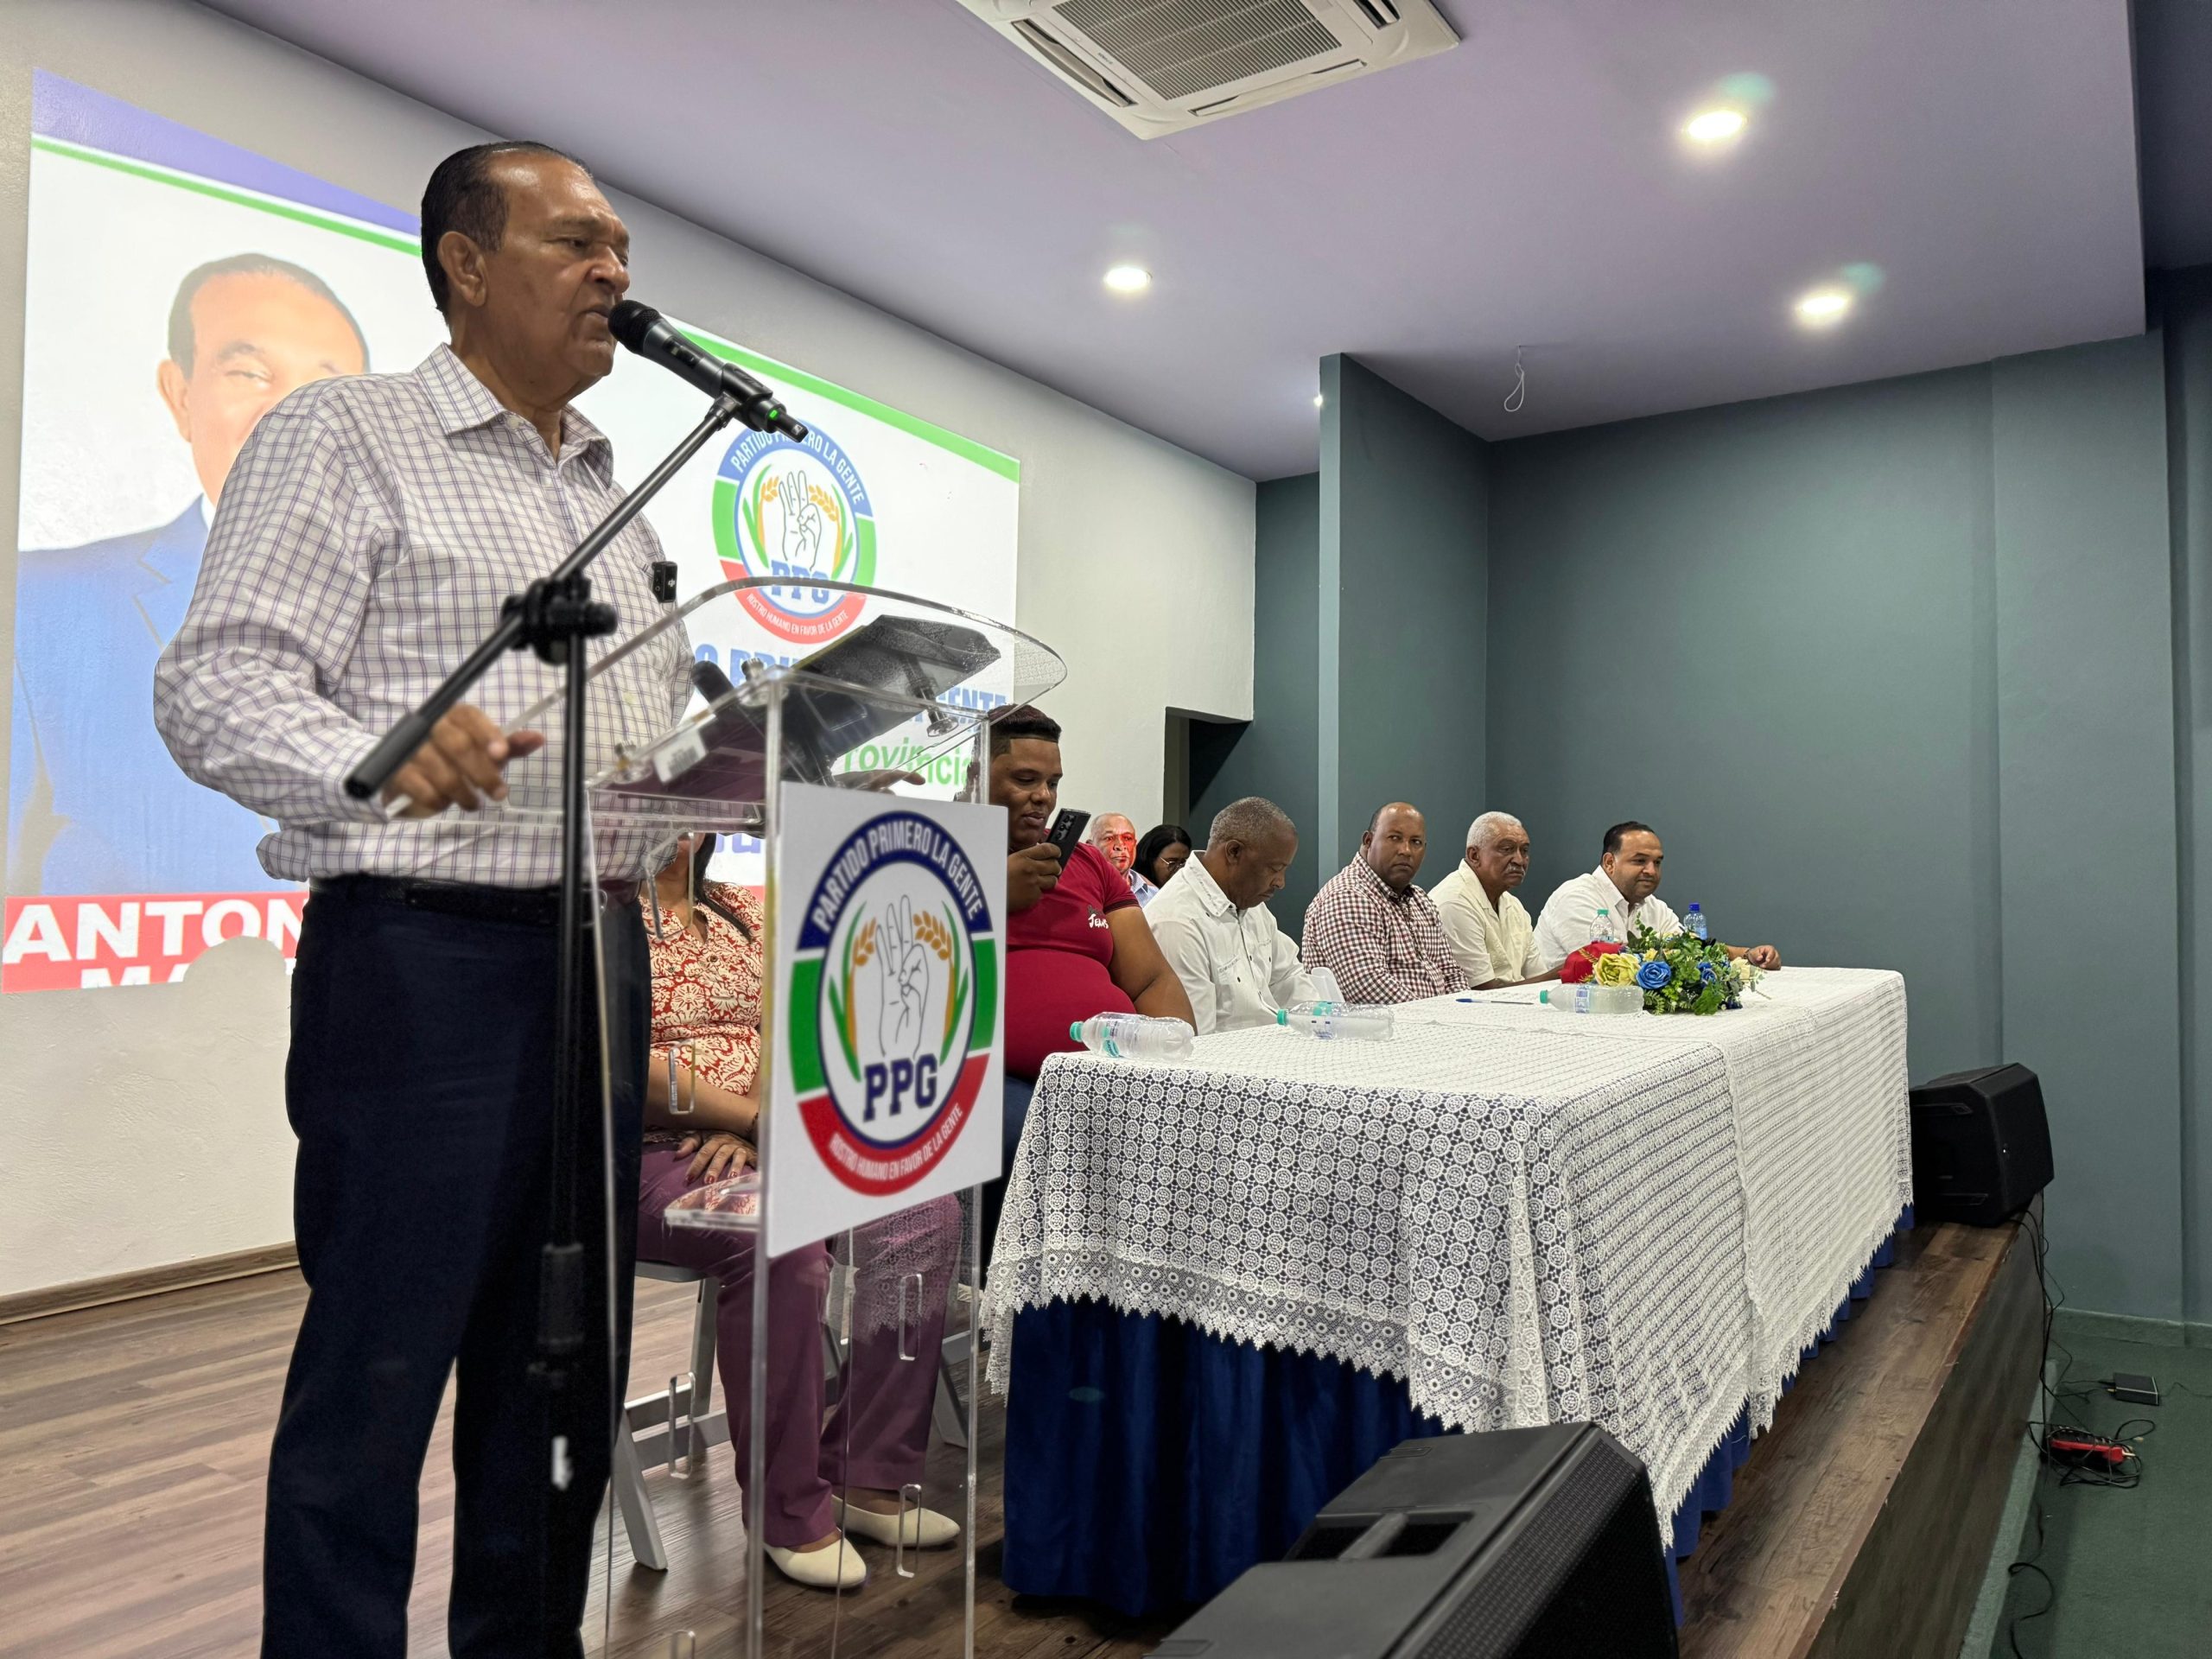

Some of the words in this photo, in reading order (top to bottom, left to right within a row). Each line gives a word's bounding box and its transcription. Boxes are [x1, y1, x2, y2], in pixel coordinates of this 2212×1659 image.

[823, 442, 837, 466] LA
[836, 458, 864, 505] GENTE
[791, 623, 799, 634] EN
[800, 624, 818, 636] FAVOR
[817, 623, 826, 635] DE
[825, 620, 834, 632] LA
[812, 836, 869, 931] PARTIDO
[868, 820, 931, 859] PRIMERO
[931, 833, 949, 868] LA
[947, 850, 982, 921] GENTE
[2, 899, 309, 964] ANTON
[862, 1053, 938, 1123] PPG
[856, 1156, 888, 1180] HUMANO
[888, 1160, 899, 1179] EN
[900, 1150, 924, 1176] FAVOR
[922, 1141, 934, 1162] DE
[932, 1132, 944, 1152] LA
[941, 1103, 963, 1140] GENTE
